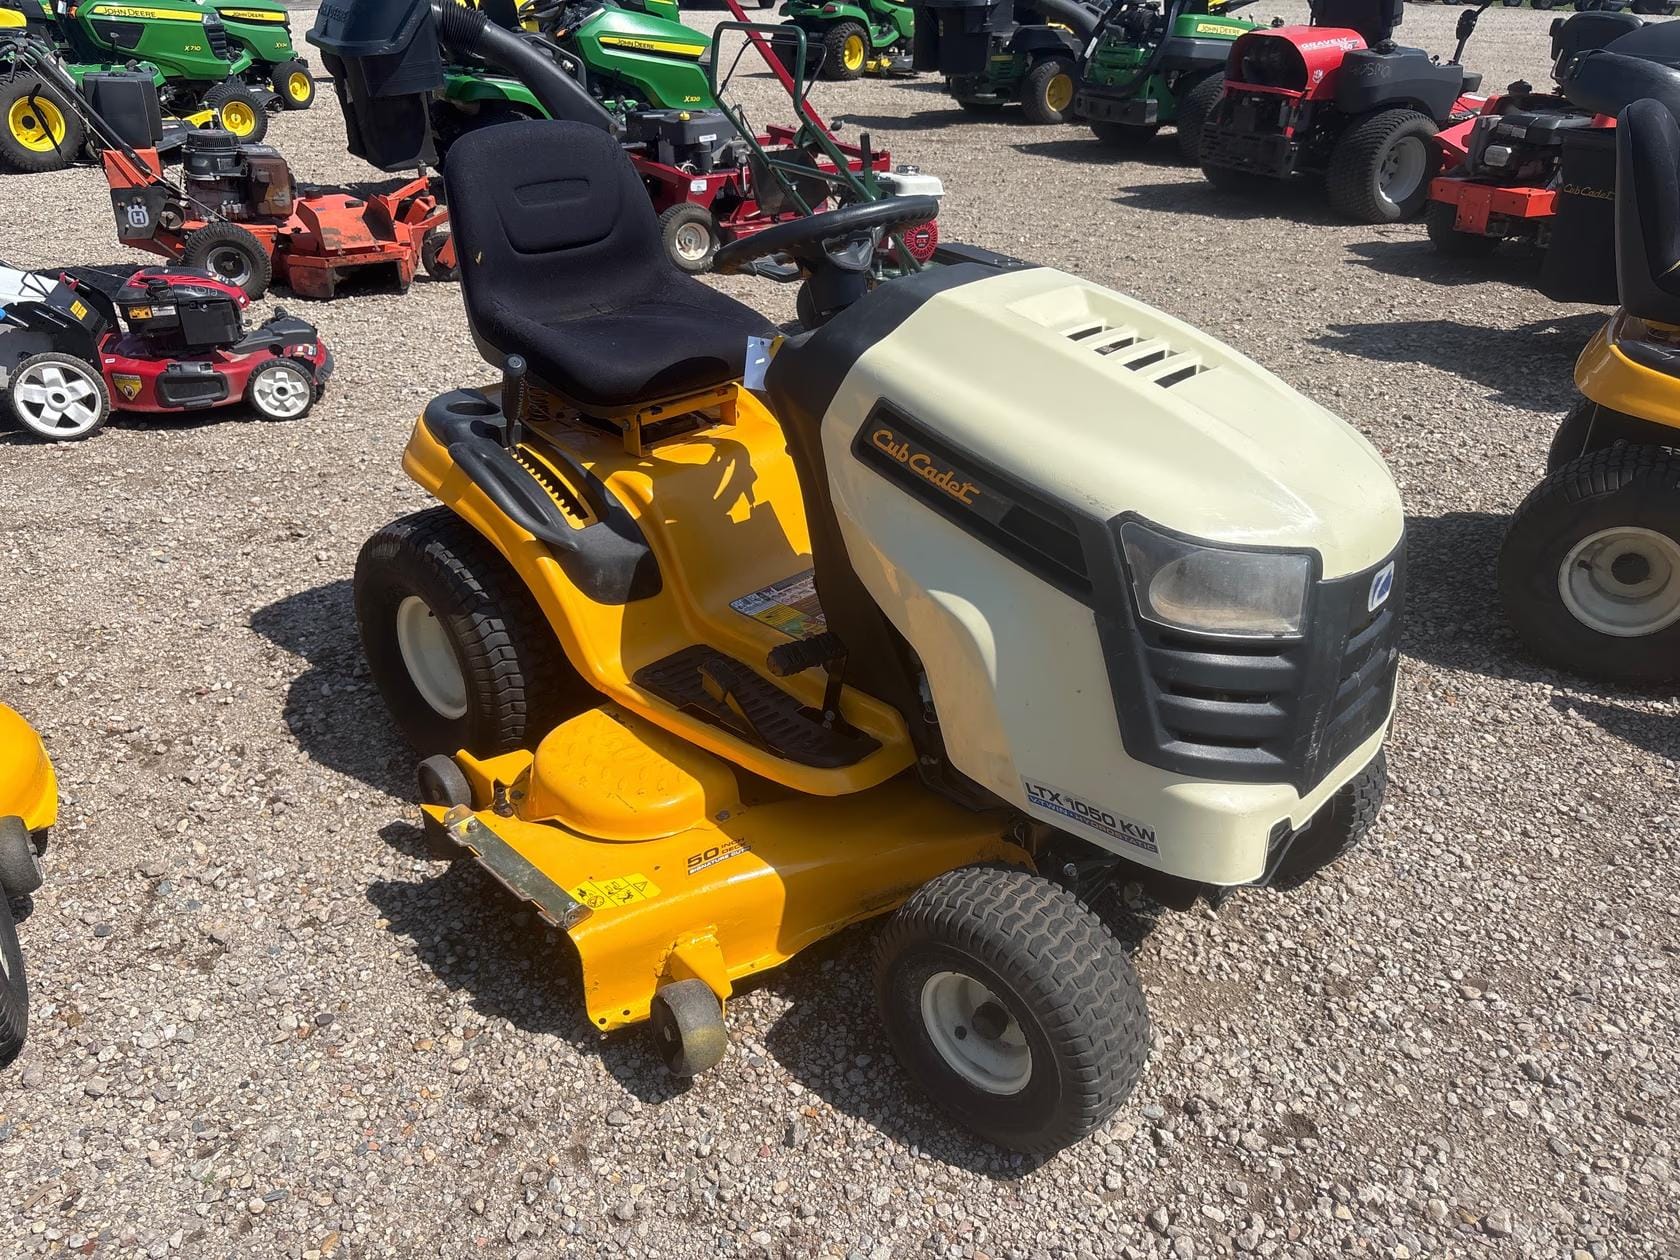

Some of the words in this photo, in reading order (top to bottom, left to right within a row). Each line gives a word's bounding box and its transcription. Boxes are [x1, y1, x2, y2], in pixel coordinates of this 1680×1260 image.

[103, 7, 126, 15] JOHN
[127, 8, 157, 18] DEERE
[1200, 24, 1219, 34] JOHN
[1220, 26, 1241, 35] DEERE
[634, 40, 656, 50] DEERE
[1301, 37, 1347, 49] GRAVELY
[1563, 183, 1580, 195] Cub
[873, 429, 909, 462] Cub
[908, 453, 981, 505] Cadet
[1025, 782, 1064, 806] LTX
[1064, 797, 1116, 828] 1050
[1120, 819, 1155, 843] KW
[688, 847, 720, 868] 50
[721, 837, 745, 849] INCH
[689, 853, 730, 874] SIGNATURE
